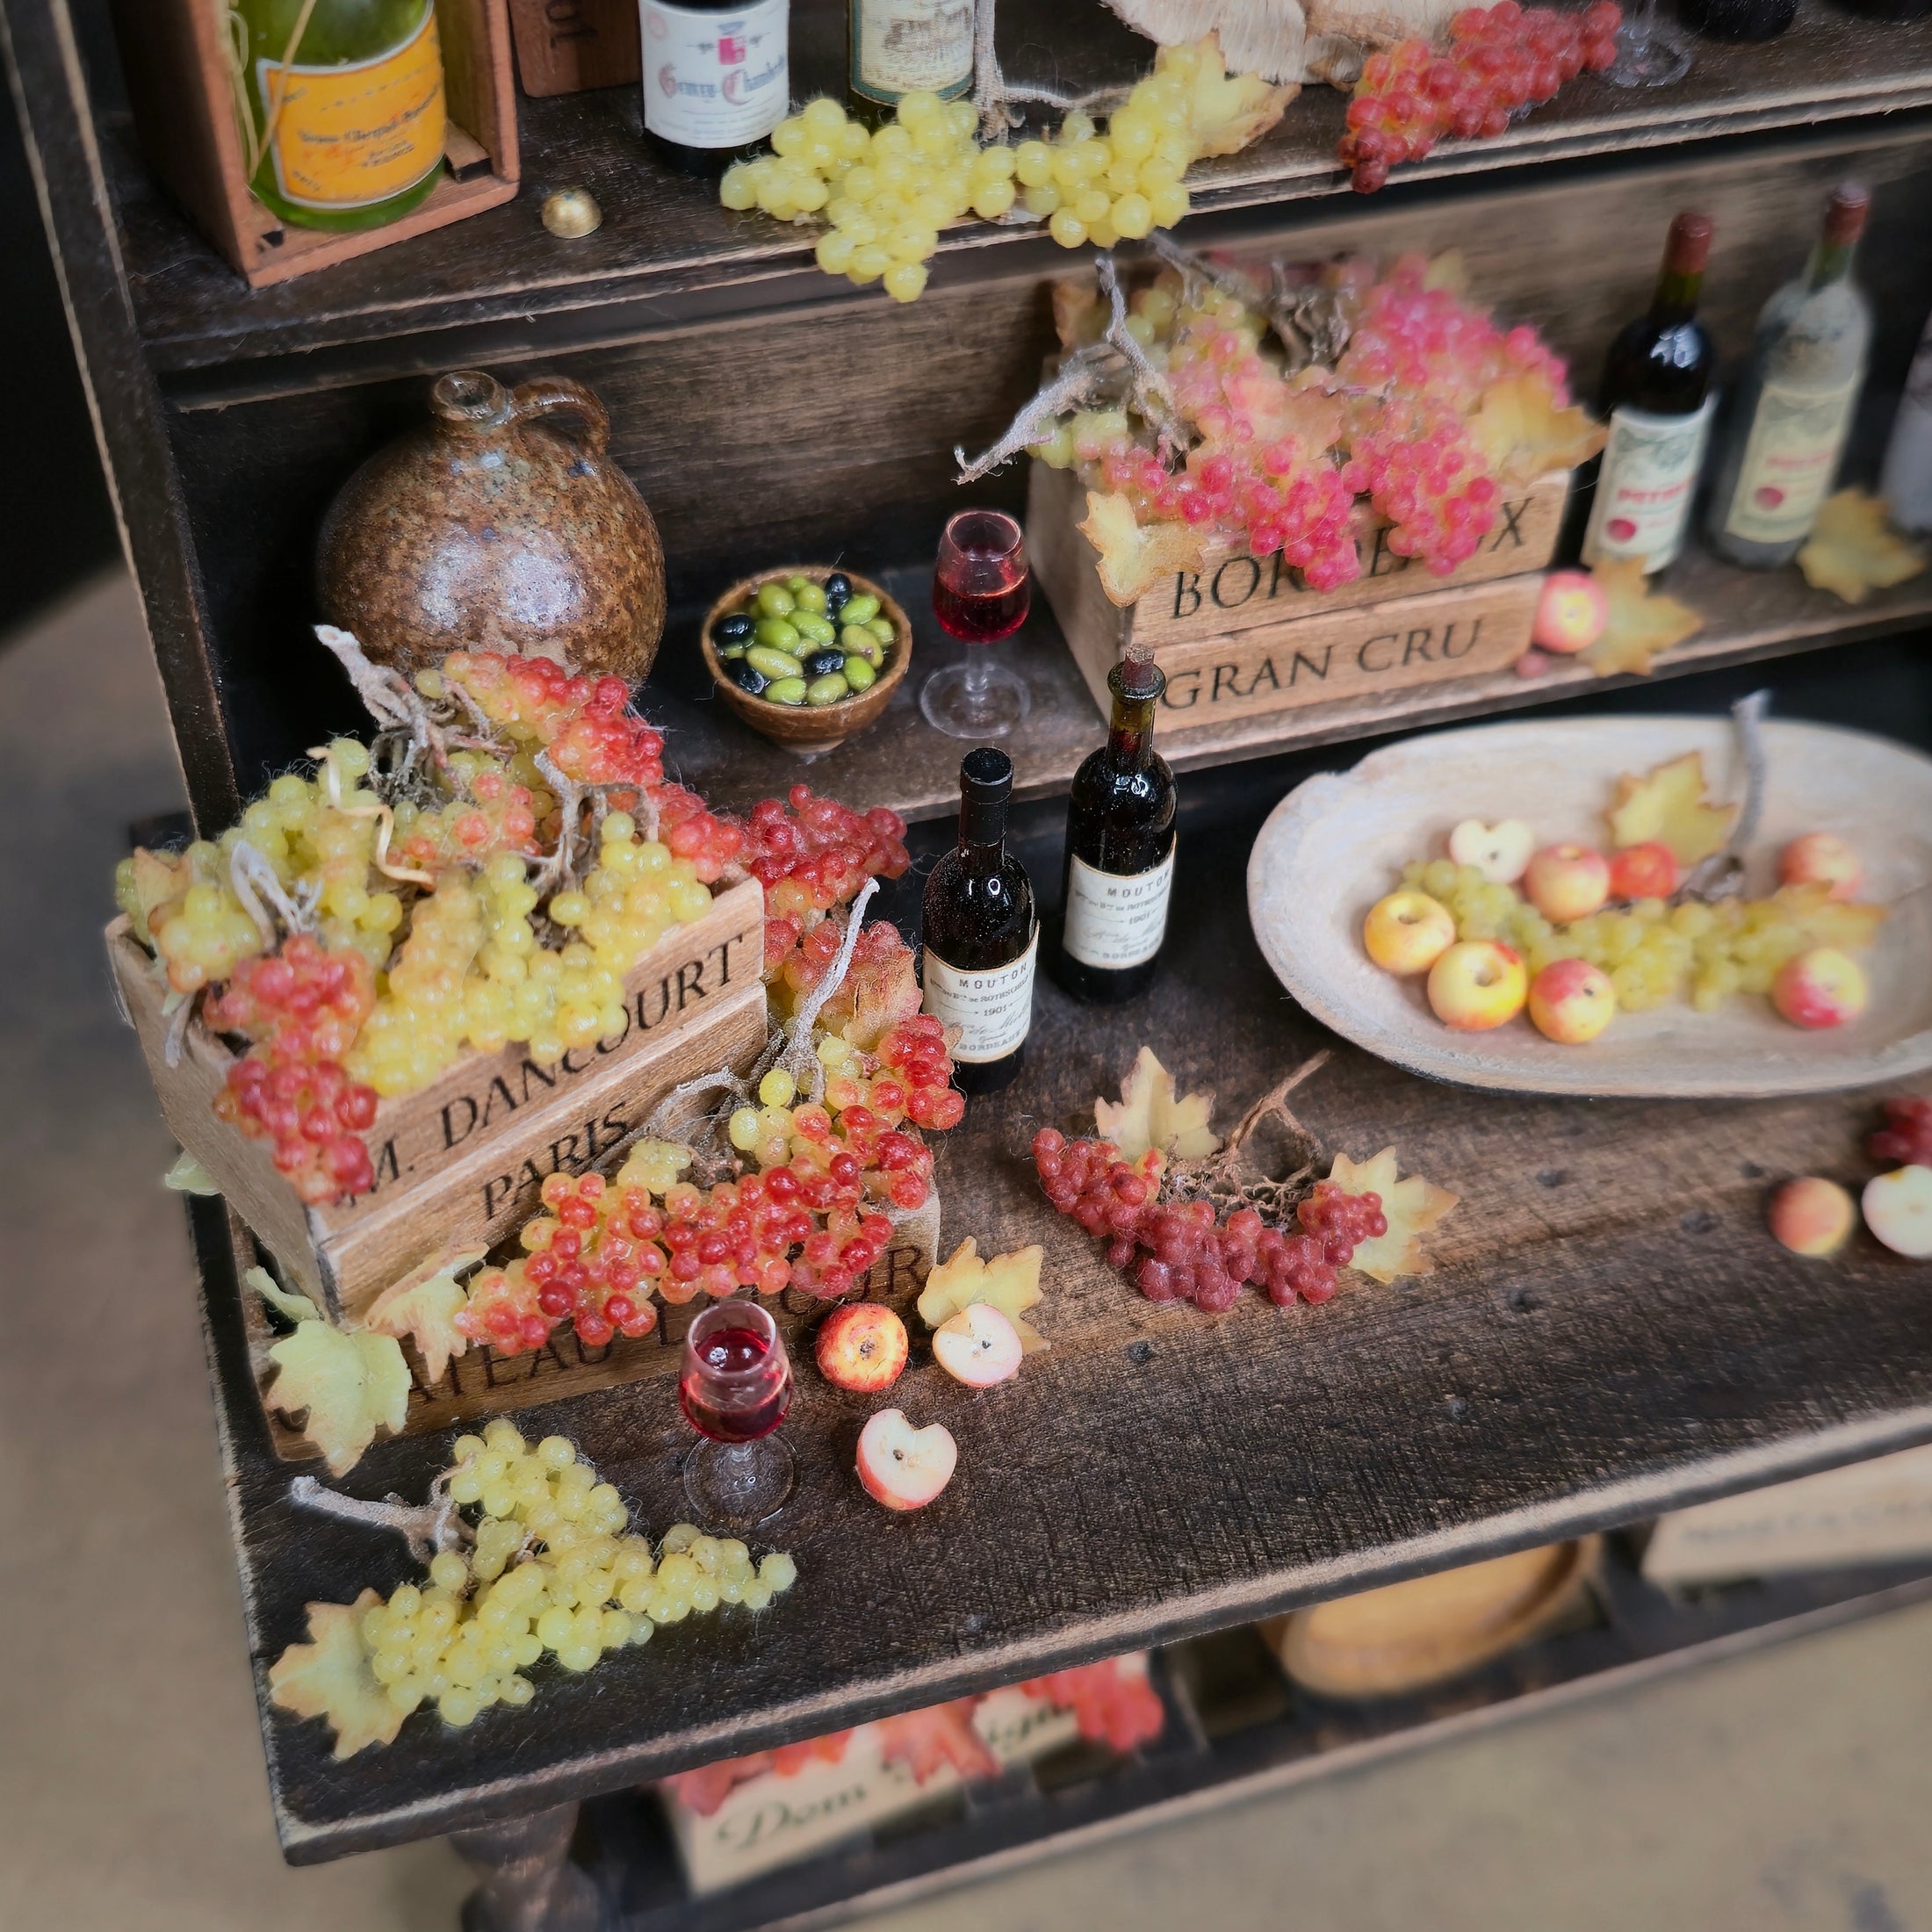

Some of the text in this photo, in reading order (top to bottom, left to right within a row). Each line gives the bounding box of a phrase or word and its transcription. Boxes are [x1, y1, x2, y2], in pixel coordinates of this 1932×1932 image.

[1161, 618, 1483, 710] GRAN CRU
[1107, 868, 1171, 899] MOUTON
[958, 961, 1027, 990] MOUTON
[483, 1100, 627, 1221] PARIS
